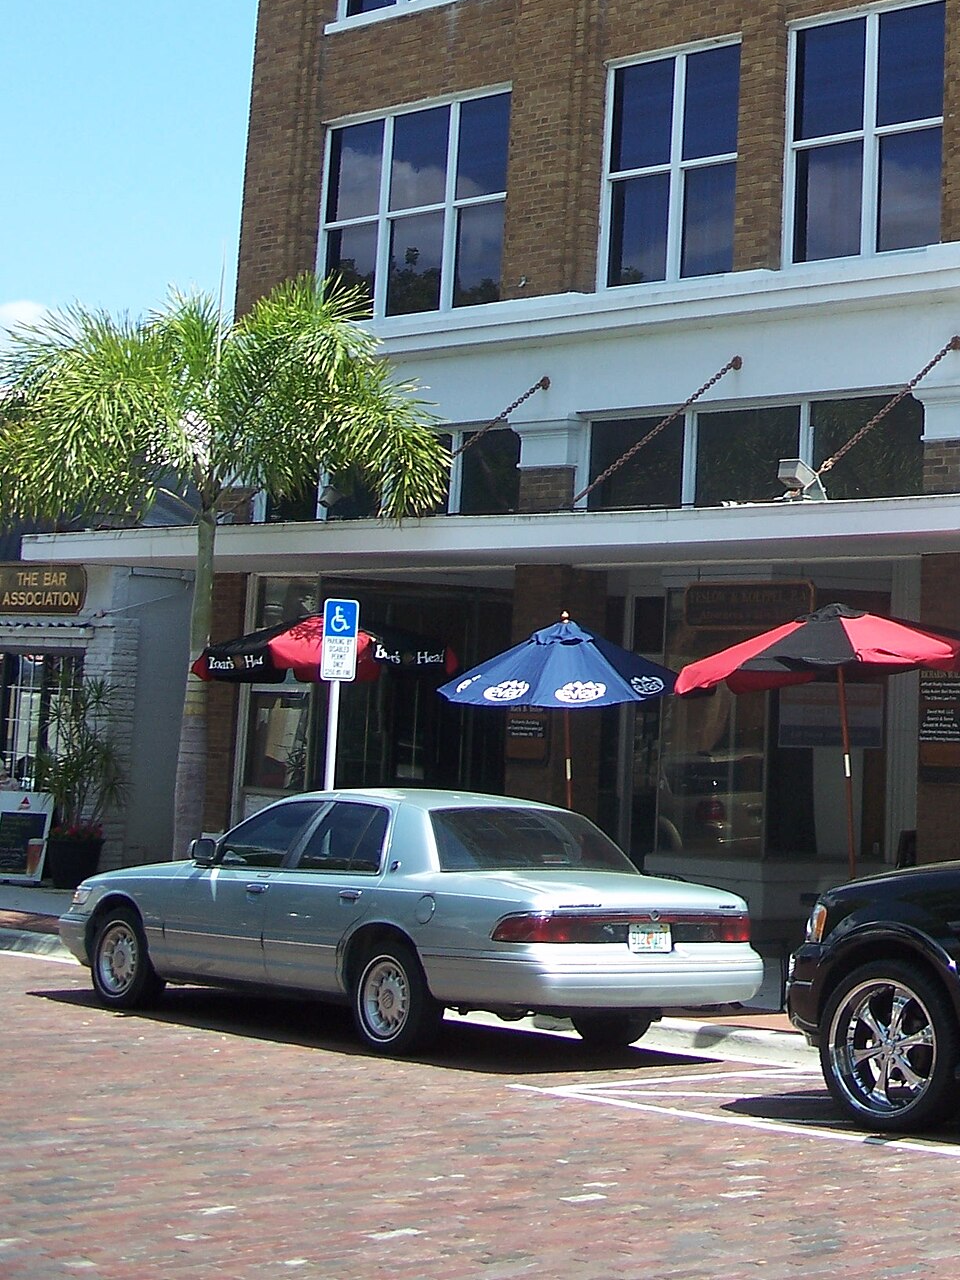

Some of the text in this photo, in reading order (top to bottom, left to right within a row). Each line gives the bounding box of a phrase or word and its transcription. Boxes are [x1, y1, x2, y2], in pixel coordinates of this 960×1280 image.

[16, 572, 67, 586] THE BAR
[2, 592, 80, 606] ASSOCIATION
